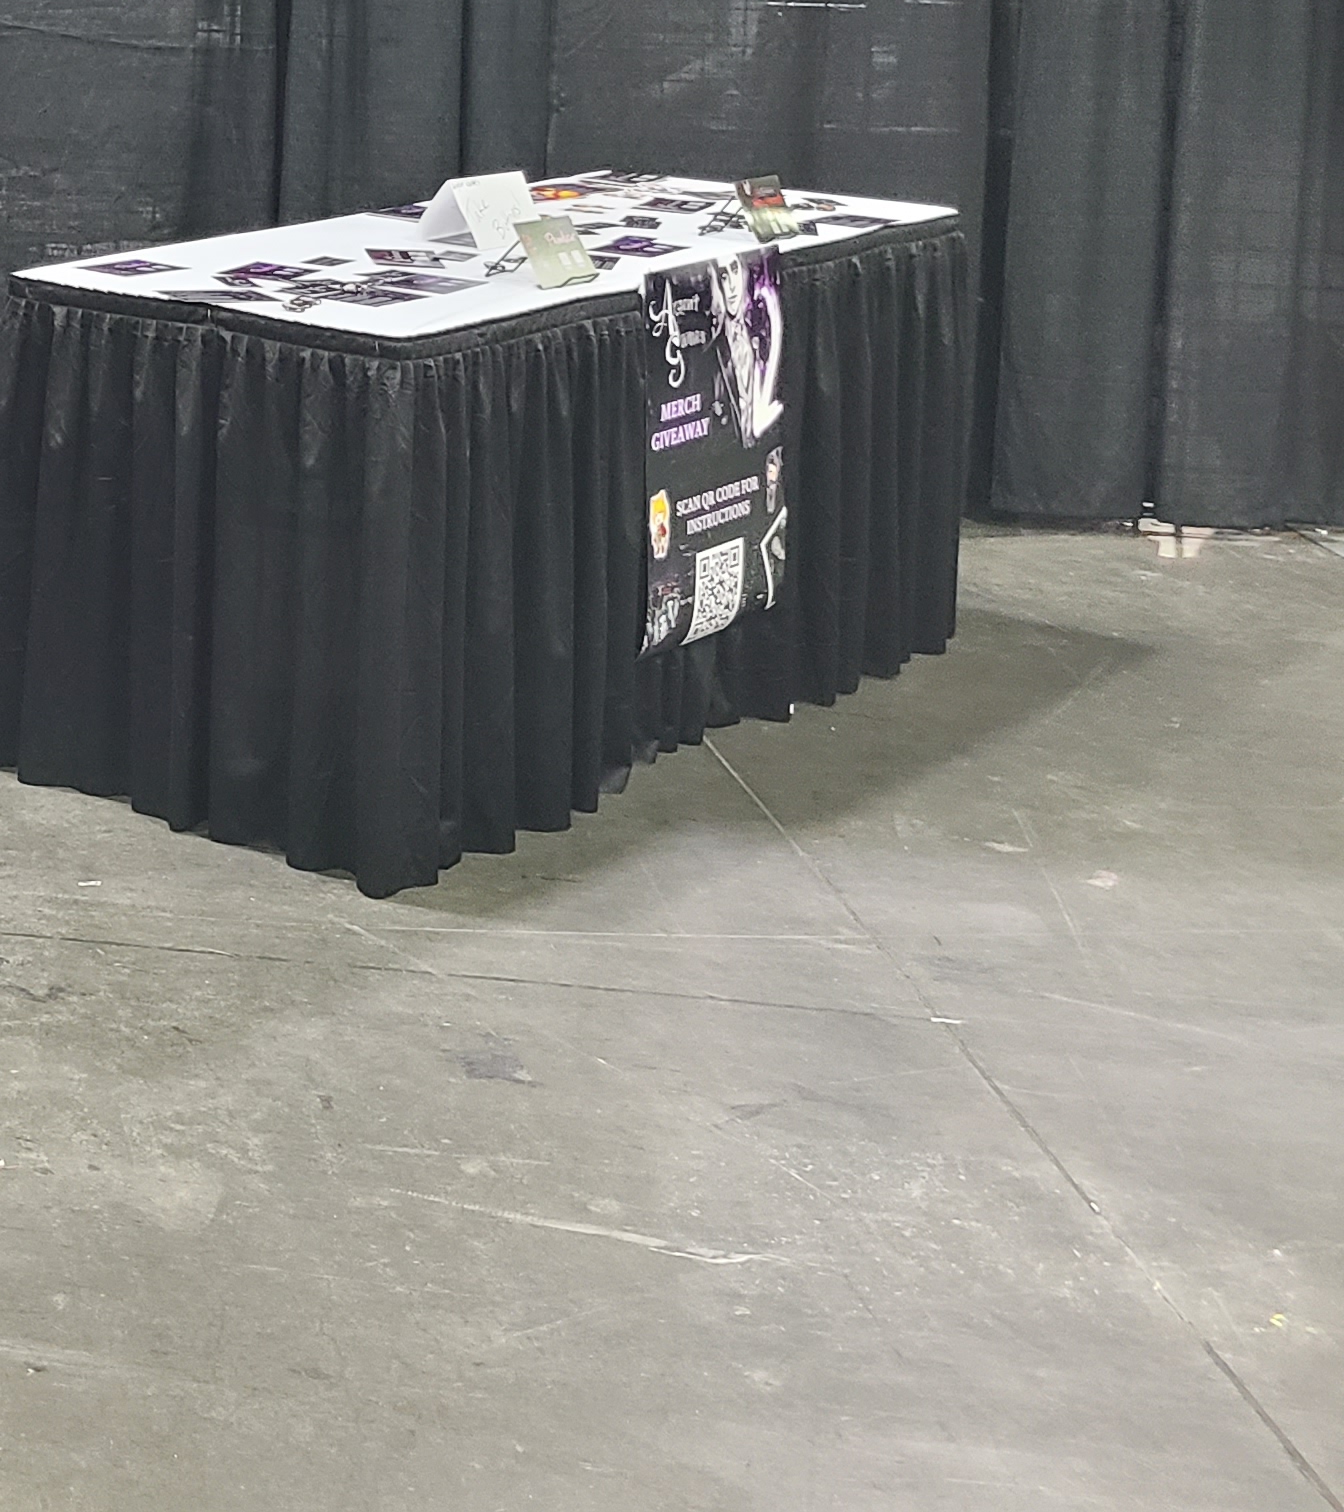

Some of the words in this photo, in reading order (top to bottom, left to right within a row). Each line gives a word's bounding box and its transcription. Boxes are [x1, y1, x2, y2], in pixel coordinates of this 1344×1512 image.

[660, 393, 702, 422] MERCH
[651, 417, 711, 451] GIVEAWAY
[675, 494, 701, 518] SCAN
[701, 490, 717, 511] QR
[715, 481, 741, 503] CODE
[740, 475, 760, 495] FOR
[686, 499, 752, 535] INSTRUCTIONS
